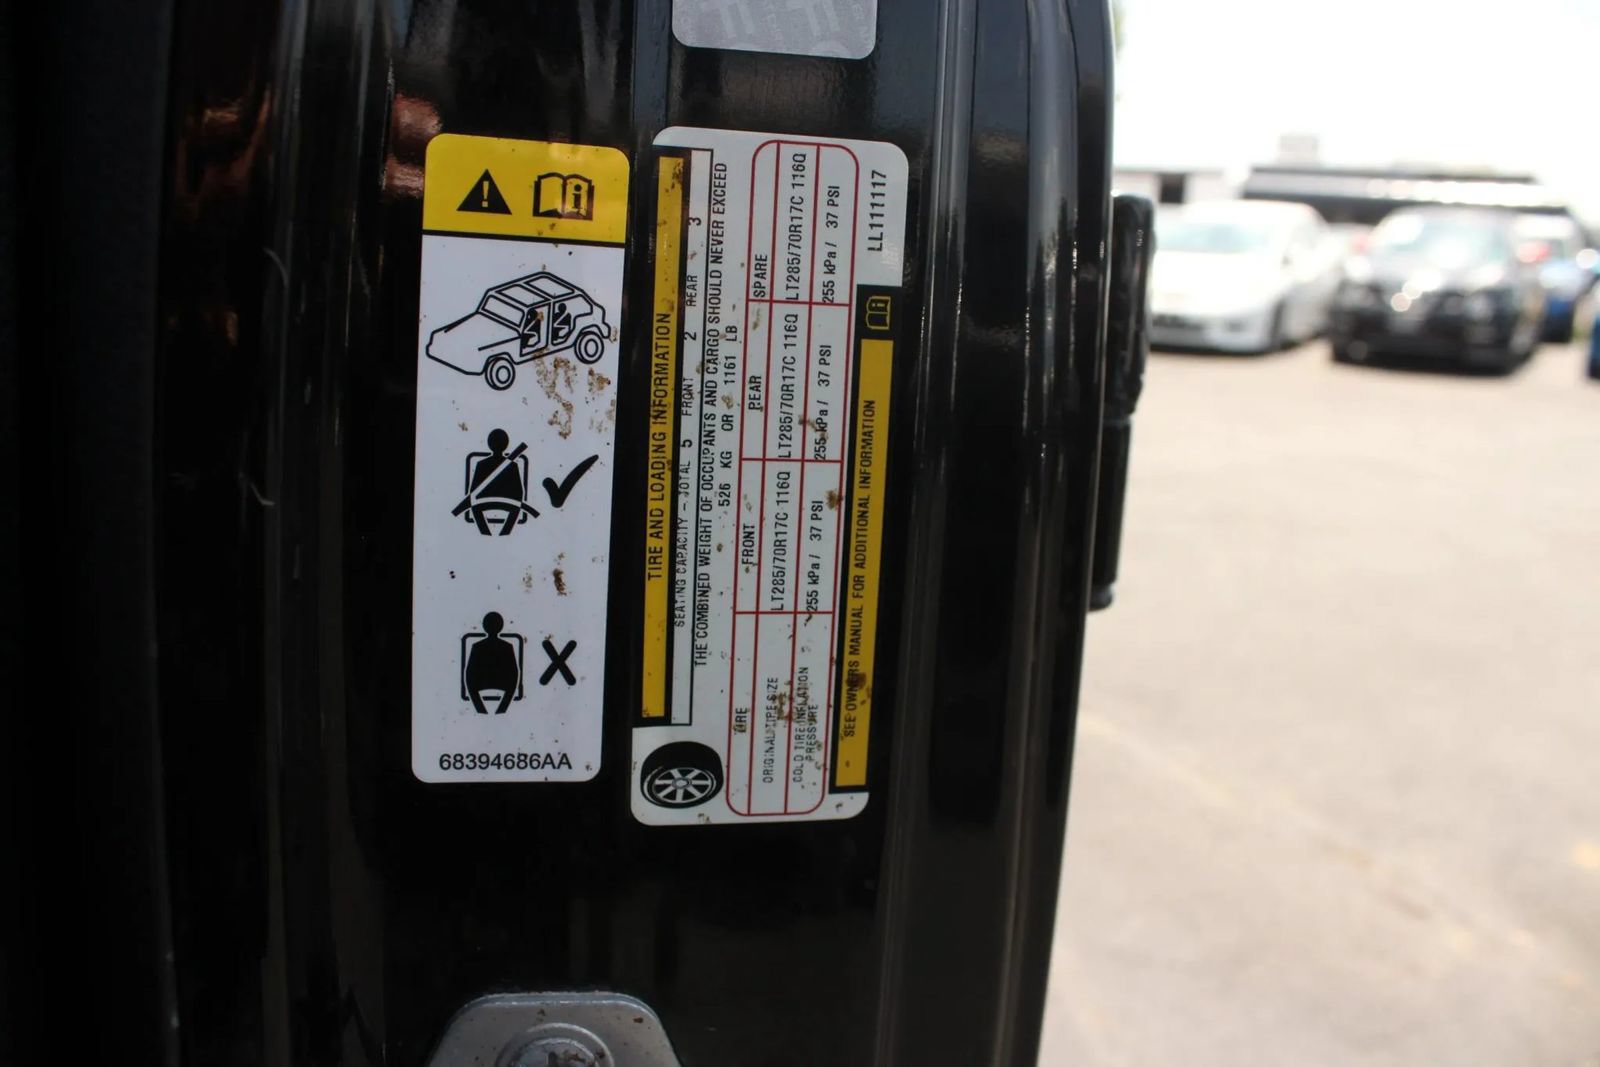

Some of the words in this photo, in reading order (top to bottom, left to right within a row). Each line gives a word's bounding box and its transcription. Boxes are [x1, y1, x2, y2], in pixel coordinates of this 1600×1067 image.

[792, 153, 806, 189] 116Q
[713, 163, 726, 214] EXCEED
[827, 186, 840, 207] PSI
[688, 217, 701, 226] 3
[826, 212, 838, 228] 37
[867, 170, 886, 252] LL111117
[710, 220, 724, 264] NEVER
[786, 196, 804, 300] LT285/70R17C
[686, 275, 698, 307] REAR
[753, 254, 767, 297] SPARE
[822, 281, 834, 303] 255
[708, 270, 722, 324] SHOULD
[684, 331, 696, 341] 2
[726, 325, 737, 342] LB
[784, 314, 798, 350] 116Q
[706, 329, 719, 374] CARGO
[819, 345, 831, 365] PSI
[652, 313, 671, 425] INFORMATION
[725, 356, 736, 385] 1161
[818, 371, 830, 387] 37
[682, 377, 694, 416] FRONT
[705, 380, 717, 407] AND
[748, 375, 762, 410] REAR
[778, 356, 796, 458] LT285/70R17C
[721, 414, 733, 431] OR
[682, 439, 692, 448] 5
[701, 412, 716, 491] OCCUPANTS
[720, 451, 732, 468] KG
[814, 438, 826, 460] 255
[859, 400, 875, 489] INFORMATION
[650, 432, 666, 501] LOADING
[701, 496, 712, 512] OF
[718, 483, 730, 506] 526
[776, 471, 790, 506] 116Q
[650, 508, 664, 539] AND
[811, 501, 824, 520] PSI
[676, 518, 687, 574] CAPACITY
[699, 518, 712, 566] WEIGHT
[742, 523, 755, 565] FRONT
[810, 526, 822, 541] 37
[854, 495, 870, 569] ADDITIONAL
[648, 546, 662, 580] TIRE
[771, 512, 788, 611] LT285/70R17C
[674, 579, 686, 628] SEATING
[807, 590, 818, 611] 255
[852, 576, 865, 598] FOR
[696, 573, 710, 638] COMBINED
[849, 605, 863, 655] MANUAL
[695, 644, 708, 667] THE
[795, 728, 806, 750] TIRE
[844, 715, 856, 737] SEE
[439, 753, 572, 770] 68394686AA
[762, 733, 775, 783] ORIGINAL
[793, 755, 805, 783] COLD
